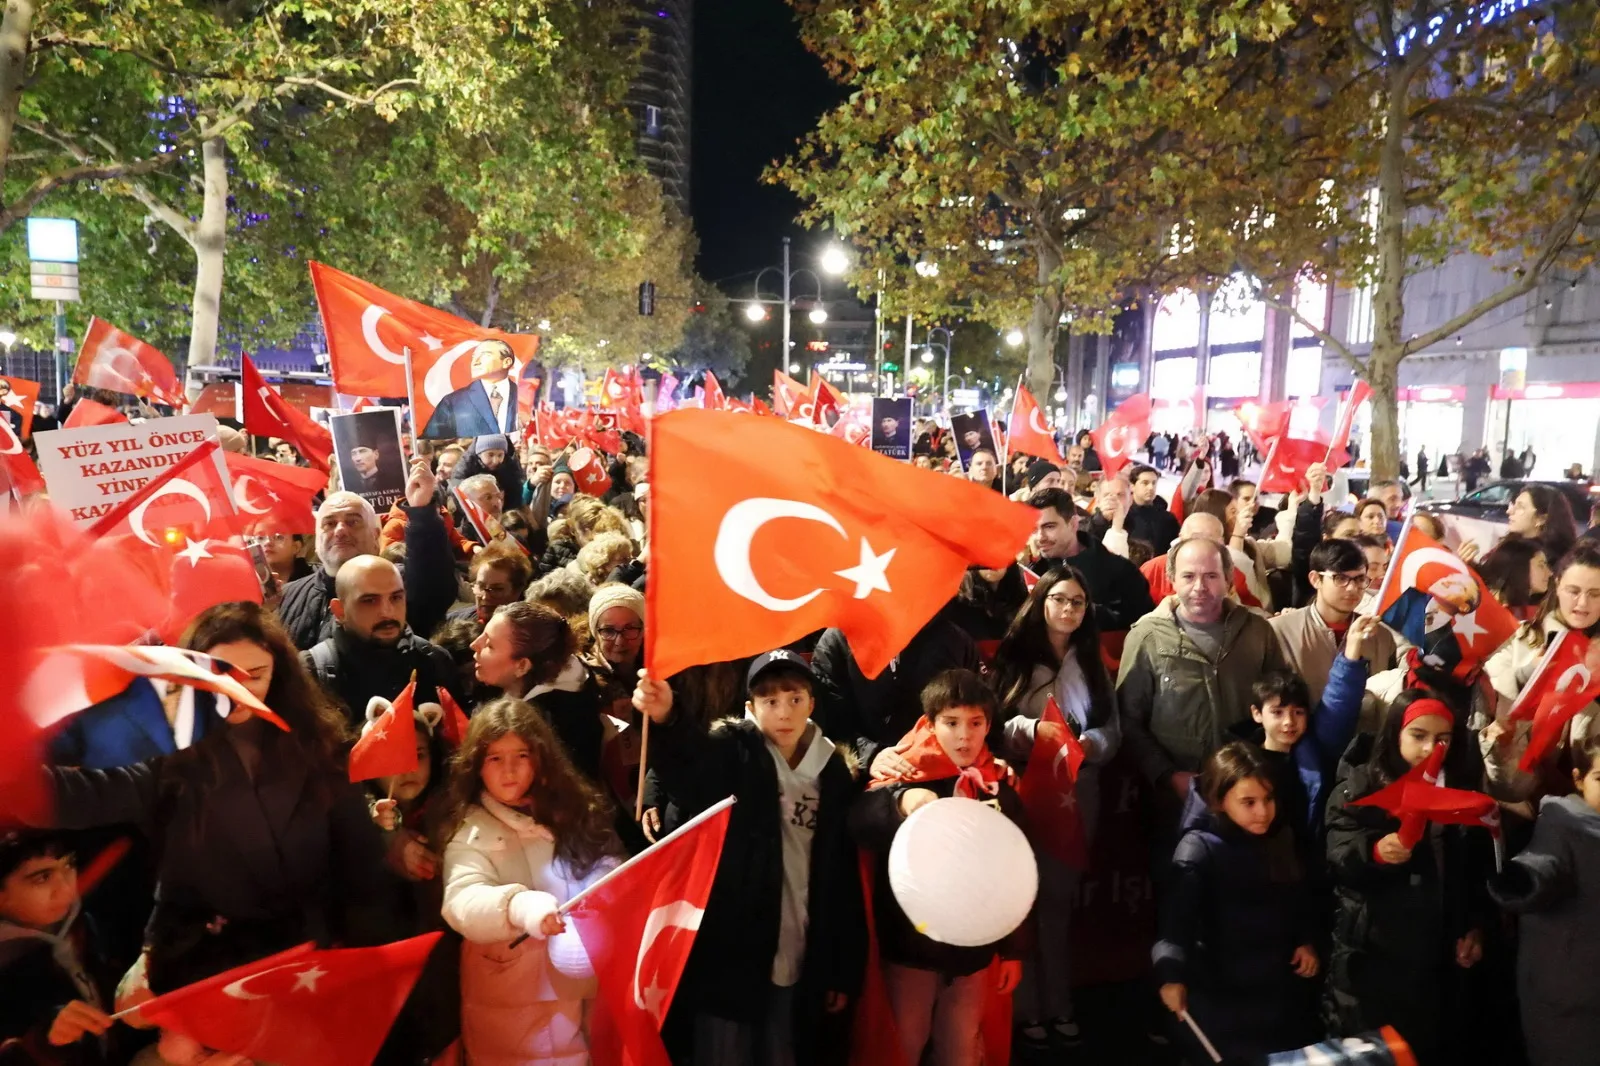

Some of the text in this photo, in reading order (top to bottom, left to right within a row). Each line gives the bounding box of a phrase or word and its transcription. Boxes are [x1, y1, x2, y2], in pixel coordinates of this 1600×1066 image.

[57, 430, 205, 459] YÜZ YIL ÖNCE
